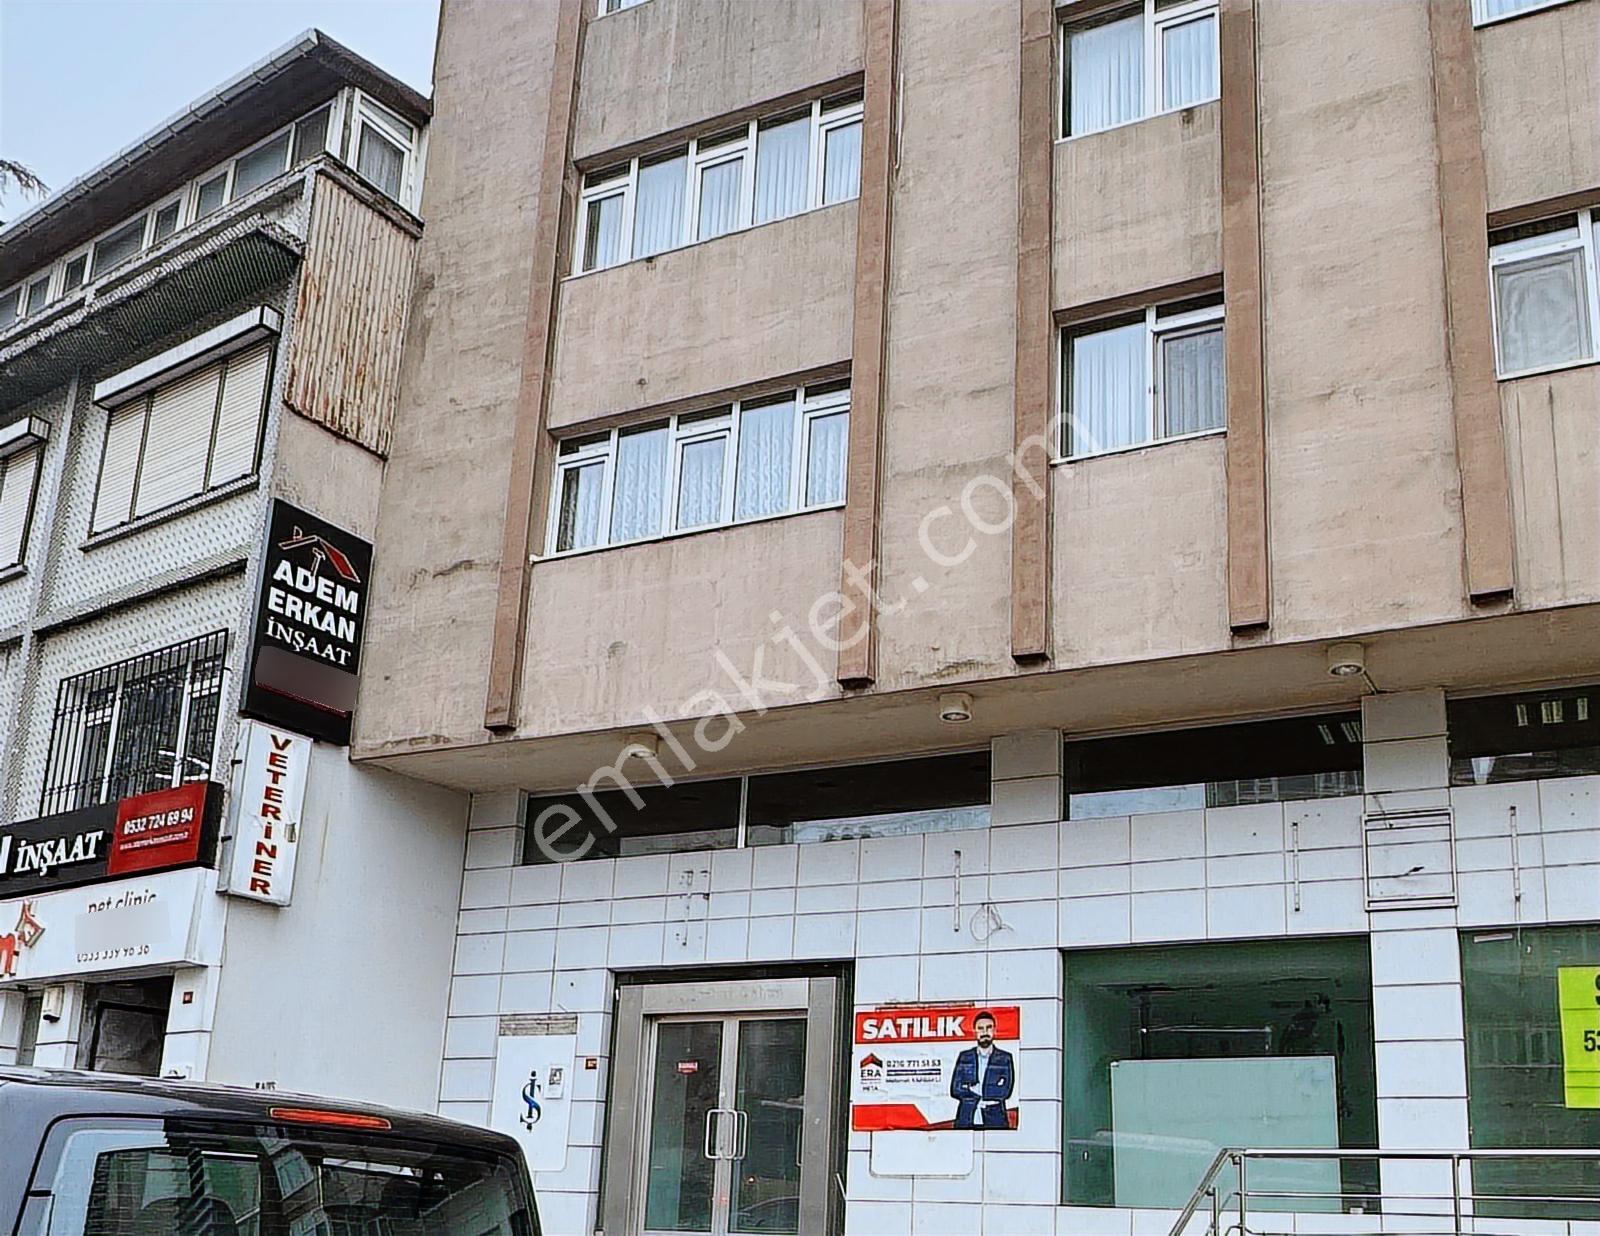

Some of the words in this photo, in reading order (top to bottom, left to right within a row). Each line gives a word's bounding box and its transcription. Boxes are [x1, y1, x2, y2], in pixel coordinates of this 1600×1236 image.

[273, 559, 359, 614] ADEM
[267, 586, 356, 644] ERKAN
[265, 616, 352, 665] İNŞAAT
[13, 830, 105, 877] İNŞAAT
[862, 1015, 966, 1040] SATILIK
[860, 1069, 882, 1078] ERA
